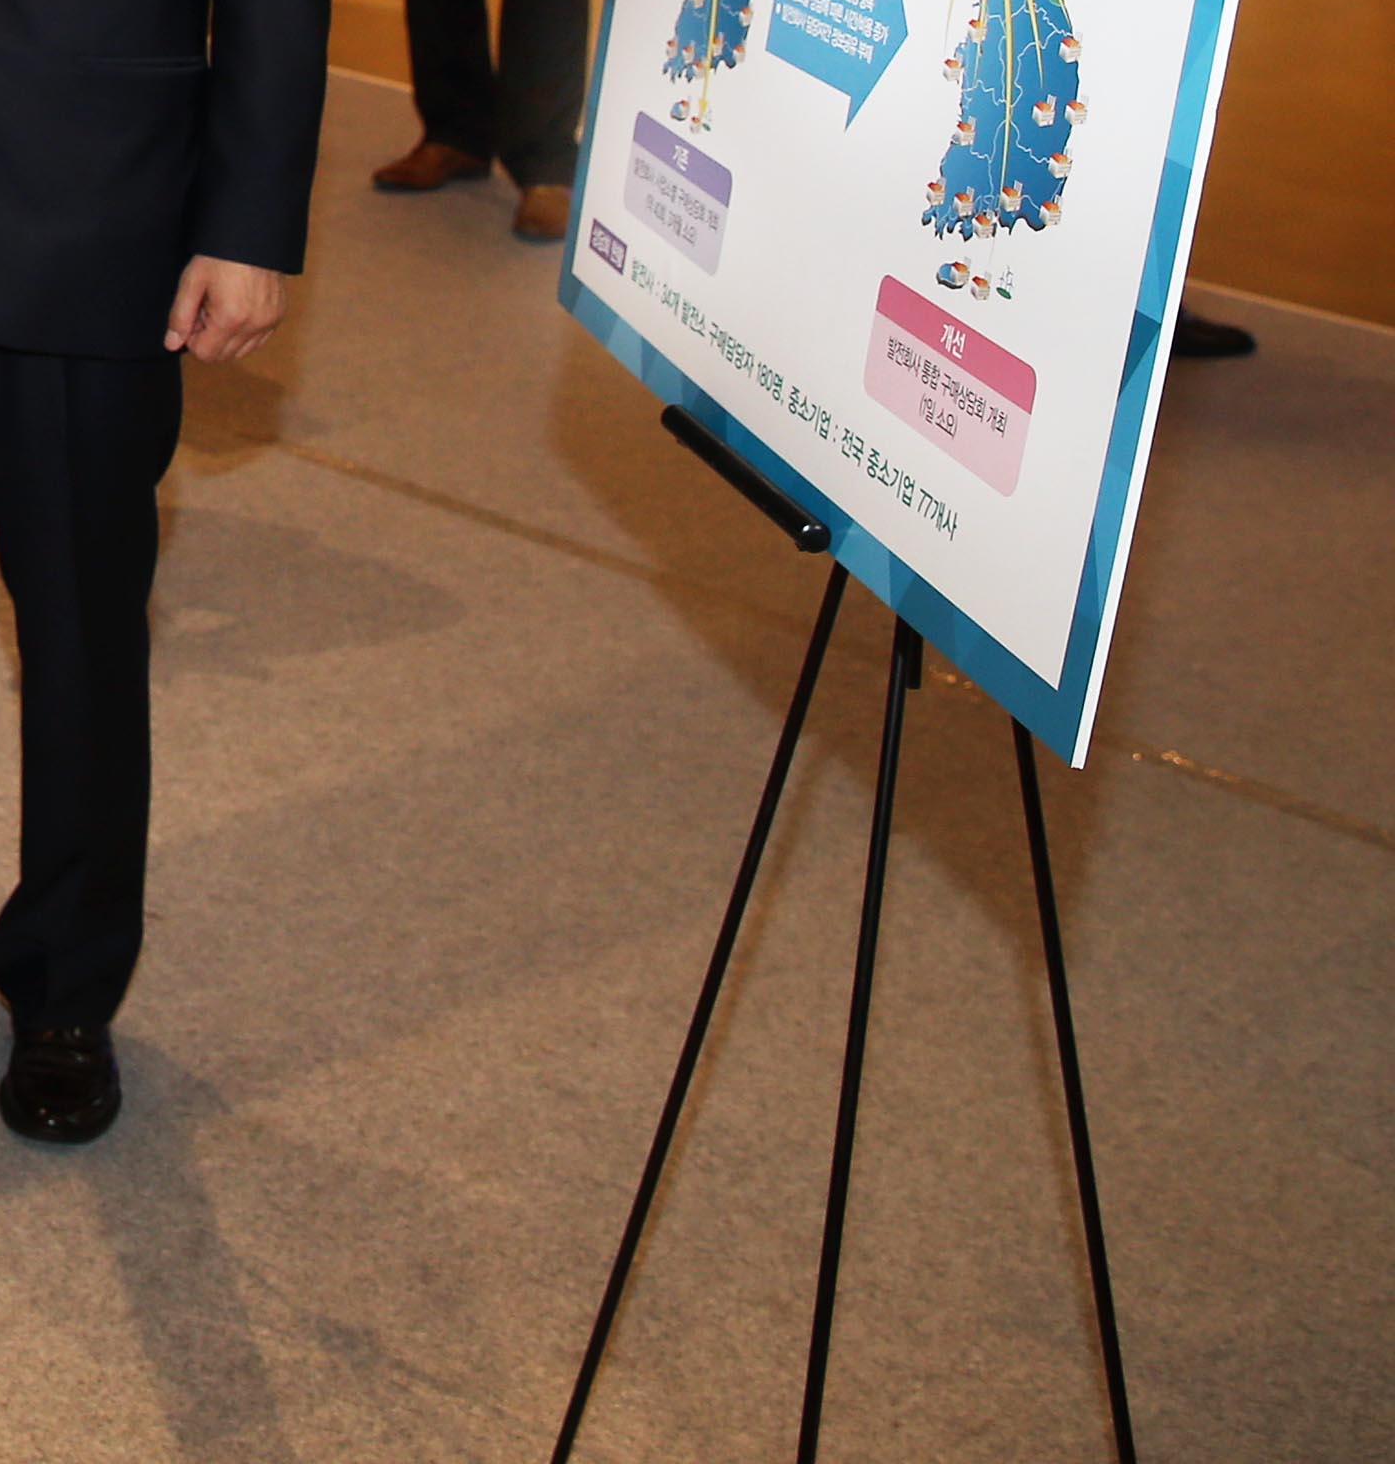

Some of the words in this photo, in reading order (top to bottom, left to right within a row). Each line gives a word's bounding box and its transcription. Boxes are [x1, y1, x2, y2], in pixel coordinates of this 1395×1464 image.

[887, 336, 921, 377] 발전회사
[921, 360, 941, 390] 통합
[941, 373, 987, 423] 구매상담회
[987, 406, 1008, 438] 개최
[941, 323, 966, 359] 개선
[788, 385, 831, 440] 중소기업
[842, 427, 864, 467] 전국
[867, 448, 915, 507] 중소기업
[917, 488, 958, 541] 77개사
